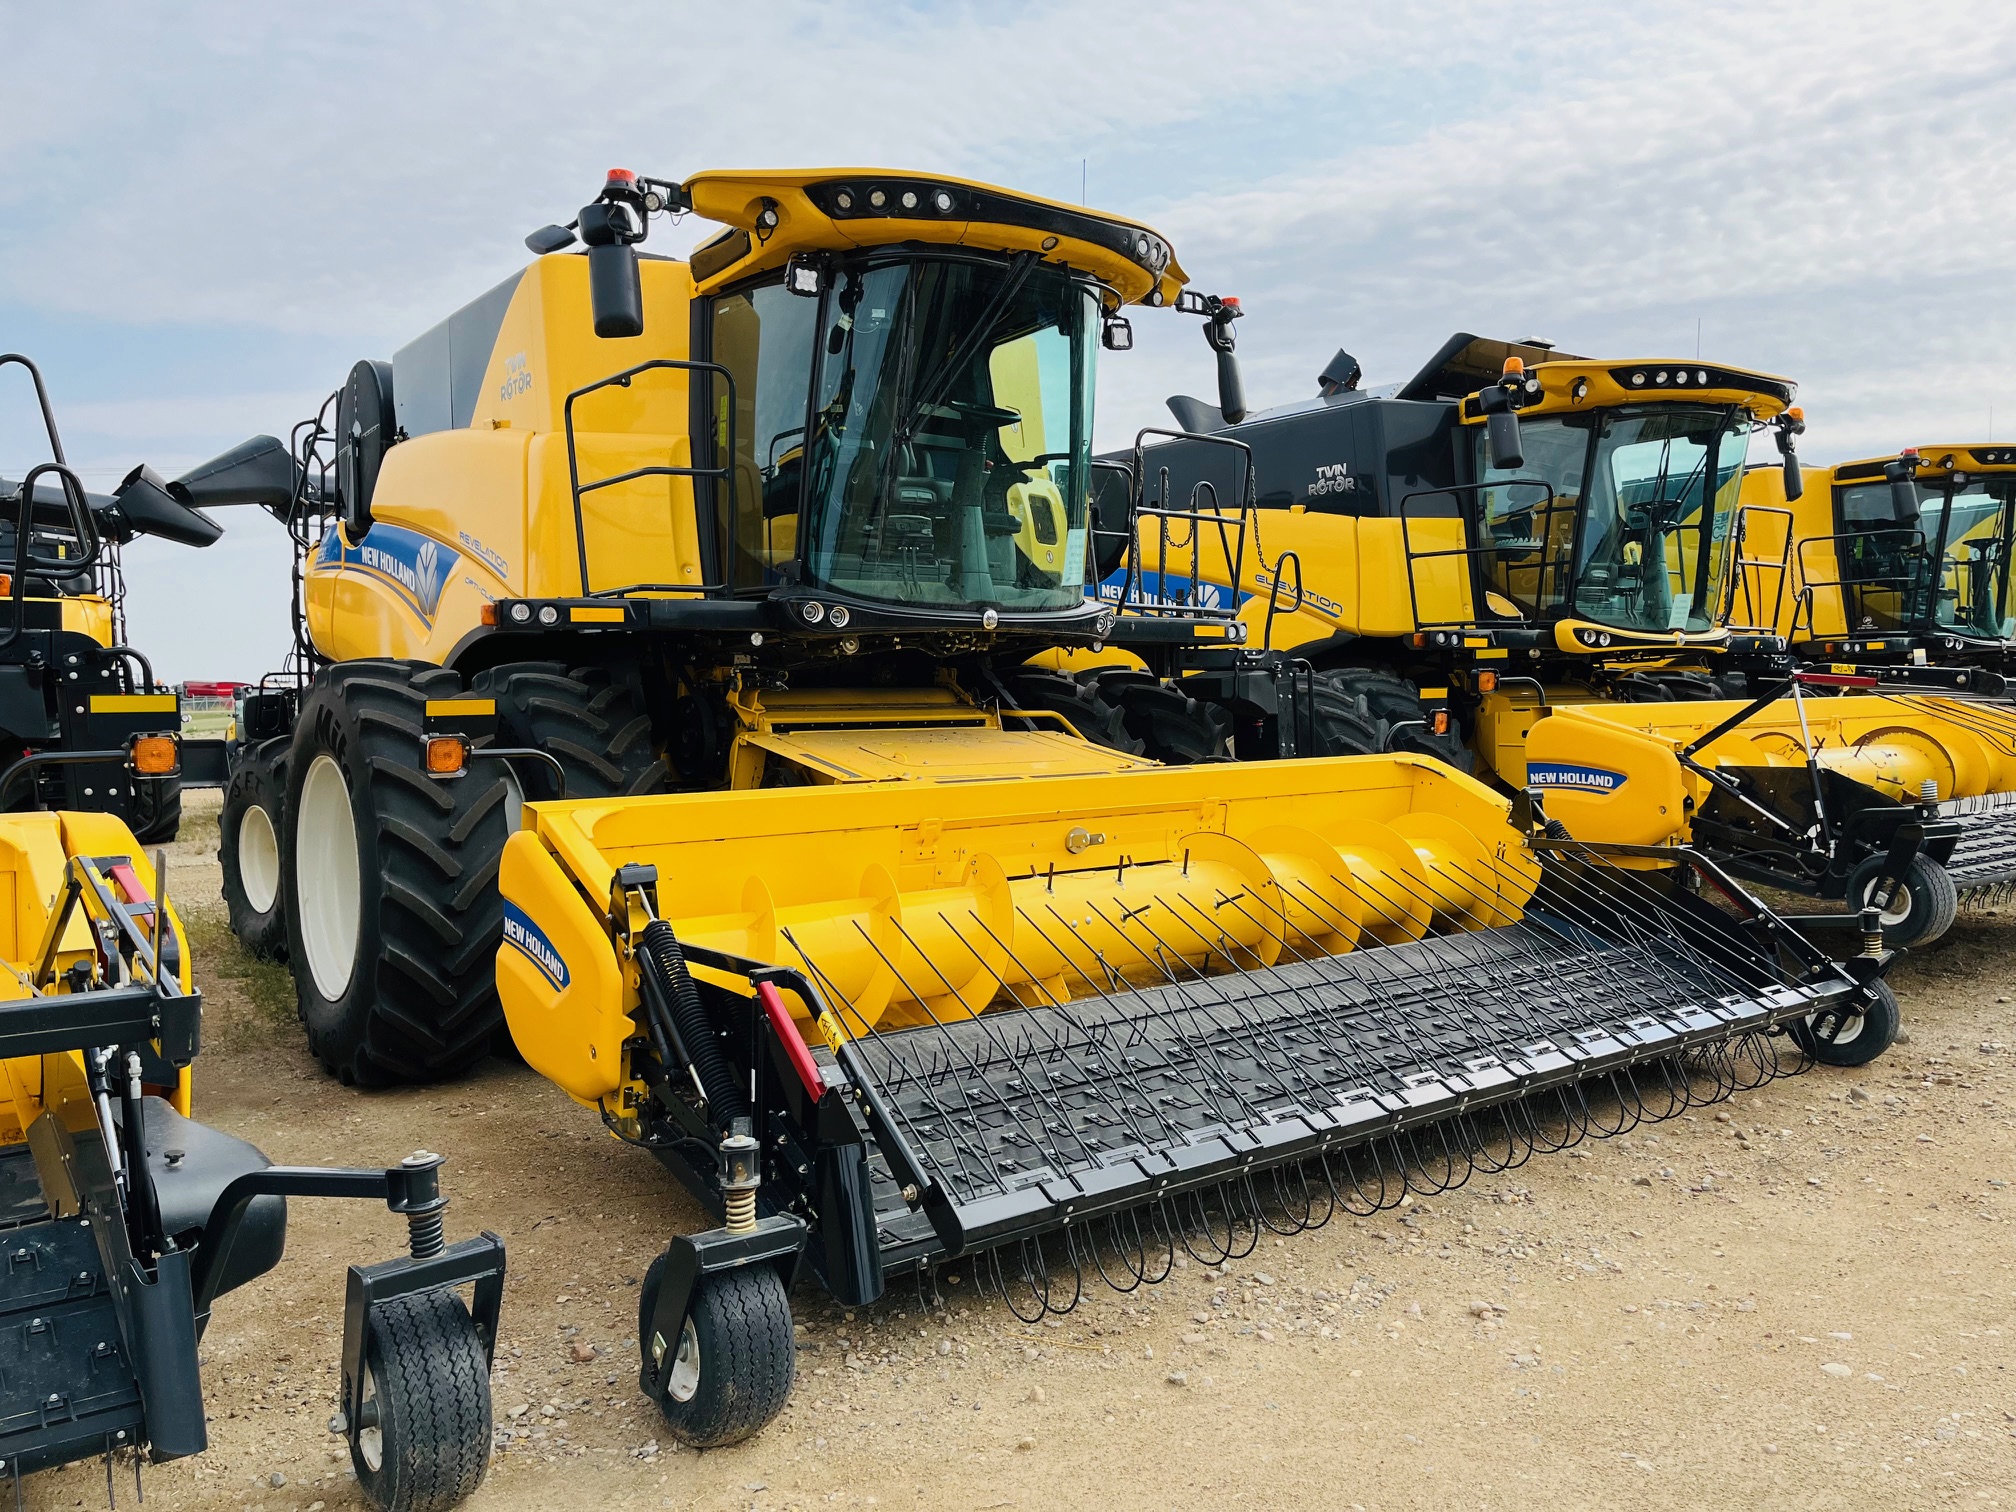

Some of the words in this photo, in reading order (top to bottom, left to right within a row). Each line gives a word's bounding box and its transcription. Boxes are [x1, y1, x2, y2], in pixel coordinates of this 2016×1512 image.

[500, 370, 532, 402] ROTOR
[1308, 475, 1356, 497] ROTOR
[1316, 462, 1347, 479] TWIN
[361, 545, 379, 568] NEW
[380, 551, 416, 592] HOLLAND
[459, 531, 508, 574] REVELATION
[1530, 773, 1557, 784] NEW
[1558, 773, 1613, 787] HOLLAND
[504, 916, 525, 944] NEW
[525, 930, 564, 982] HOLLAND
